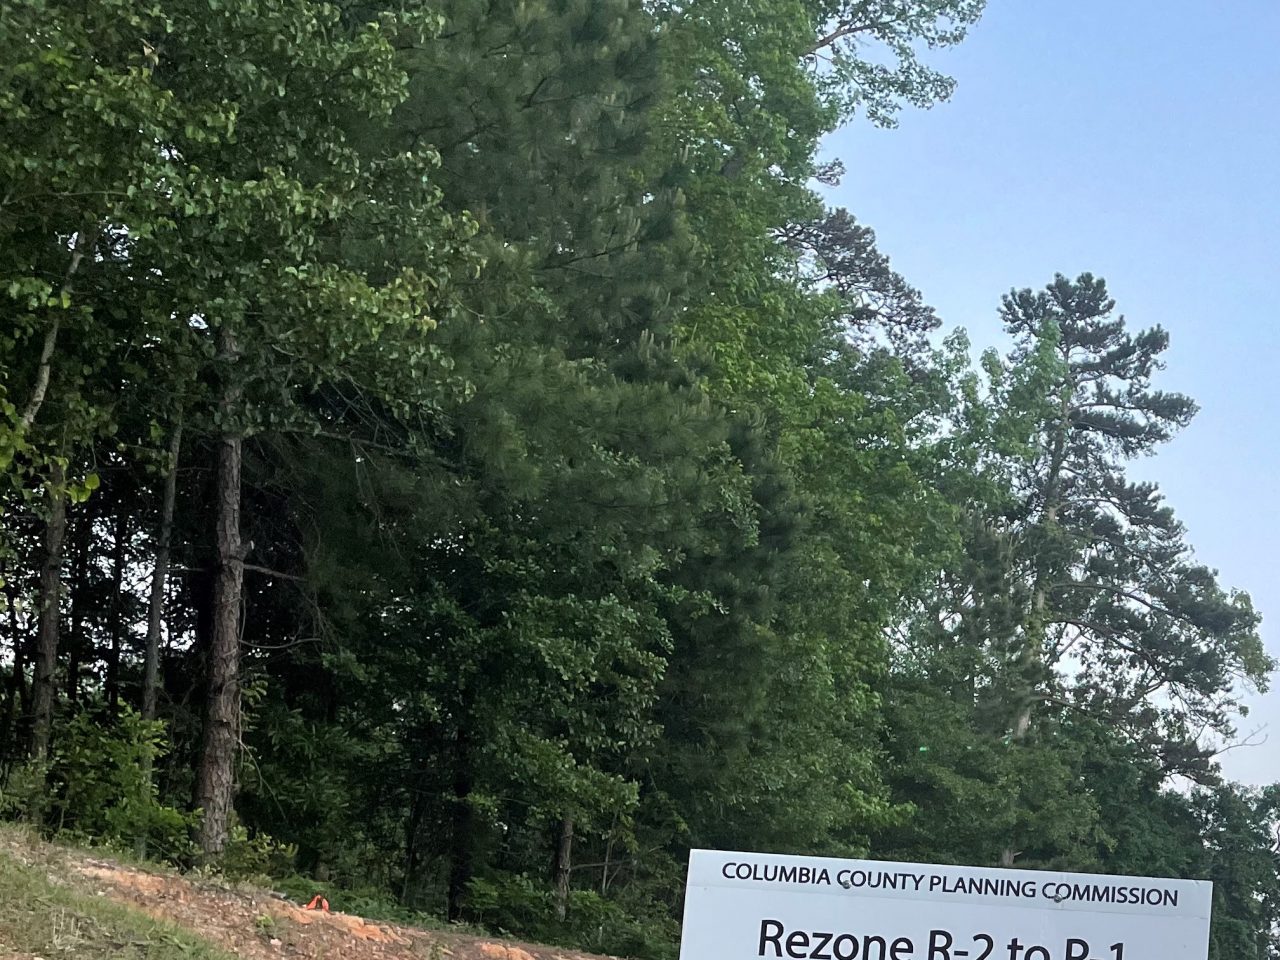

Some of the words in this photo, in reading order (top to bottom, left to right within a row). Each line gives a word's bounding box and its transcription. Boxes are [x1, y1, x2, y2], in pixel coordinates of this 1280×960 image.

[721, 862, 832, 886] COLUMBIA
[836, 869, 926, 891] COUNTY
[929, 875, 1037, 898] PLANNING
[1041, 882, 1178, 907] COMMISSION
